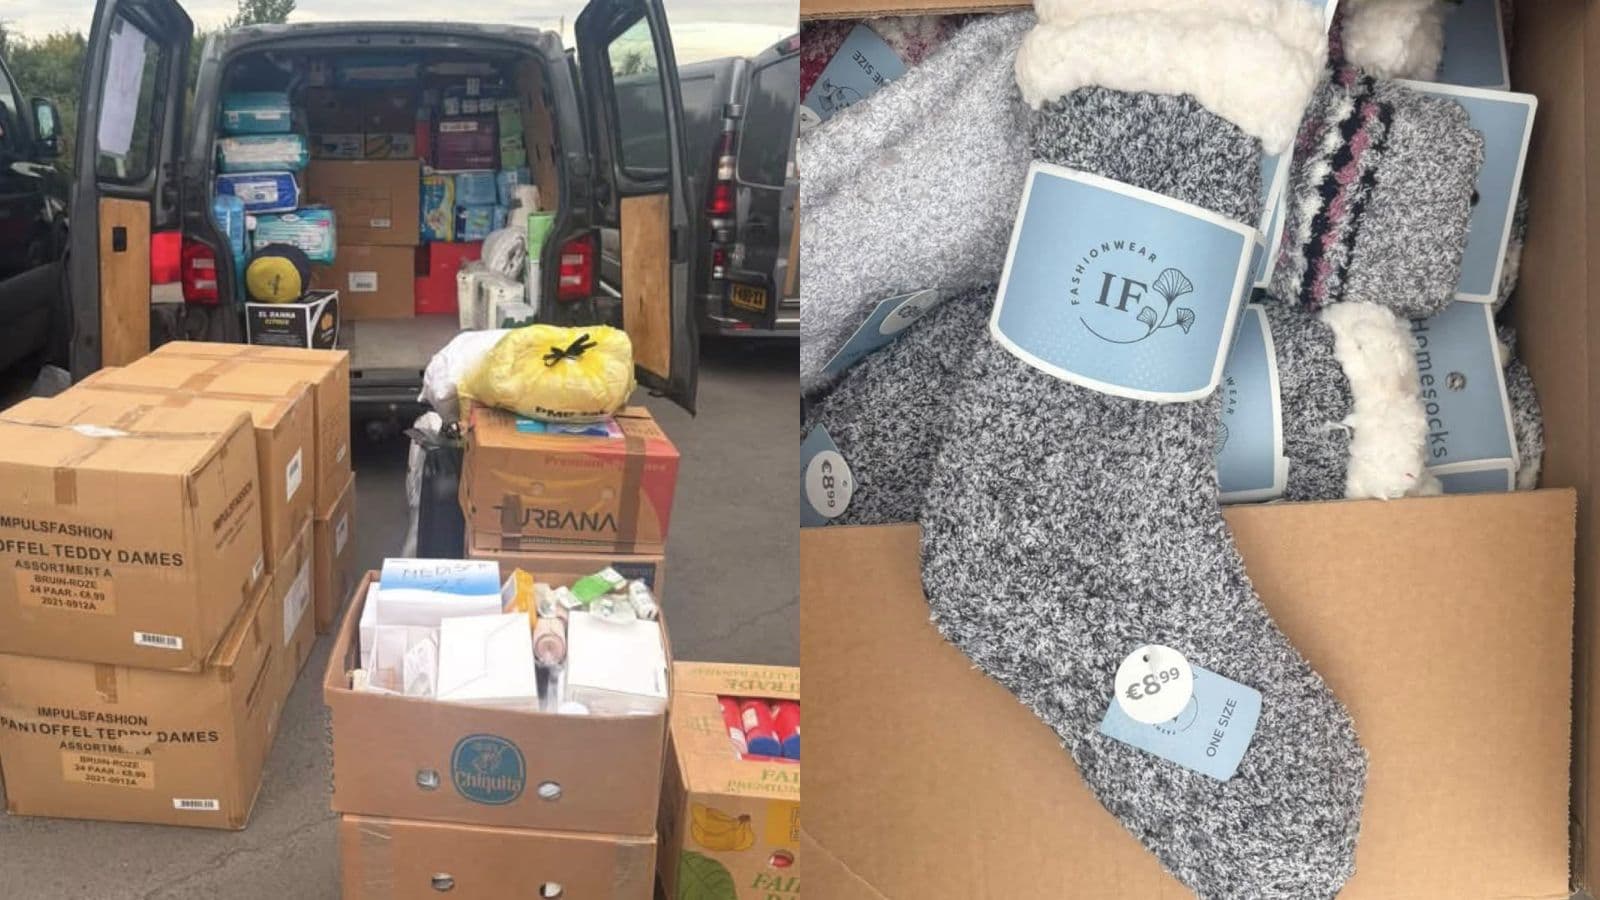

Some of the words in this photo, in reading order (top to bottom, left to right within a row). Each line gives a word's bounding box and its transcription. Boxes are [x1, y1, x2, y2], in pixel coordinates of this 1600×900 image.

[852, 50, 874, 75] SIZE
[1070, 239, 1157, 306] FASHIONWEAR
[1095, 271, 1149, 313] IF
[1409, 317, 1448, 459] Homesocks
[52, 543, 112, 562] TEDDY
[118, 550, 184, 567] DAMES
[15, 559, 101, 578] ASSORTMENT
[103, 567, 113, 578] A
[43, 586, 72, 597] PAAR
[38, 706, 148, 727] IMPULSFASHION
[1205, 729, 1225, 758] ONE
[1218, 697, 1238, 728] SIZE
[59, 741, 142, 755] ASSORTME
[143, 747, 152, 756] A
[157, 731, 220, 744] DAMES
[454, 770, 522, 794] Chiquita
